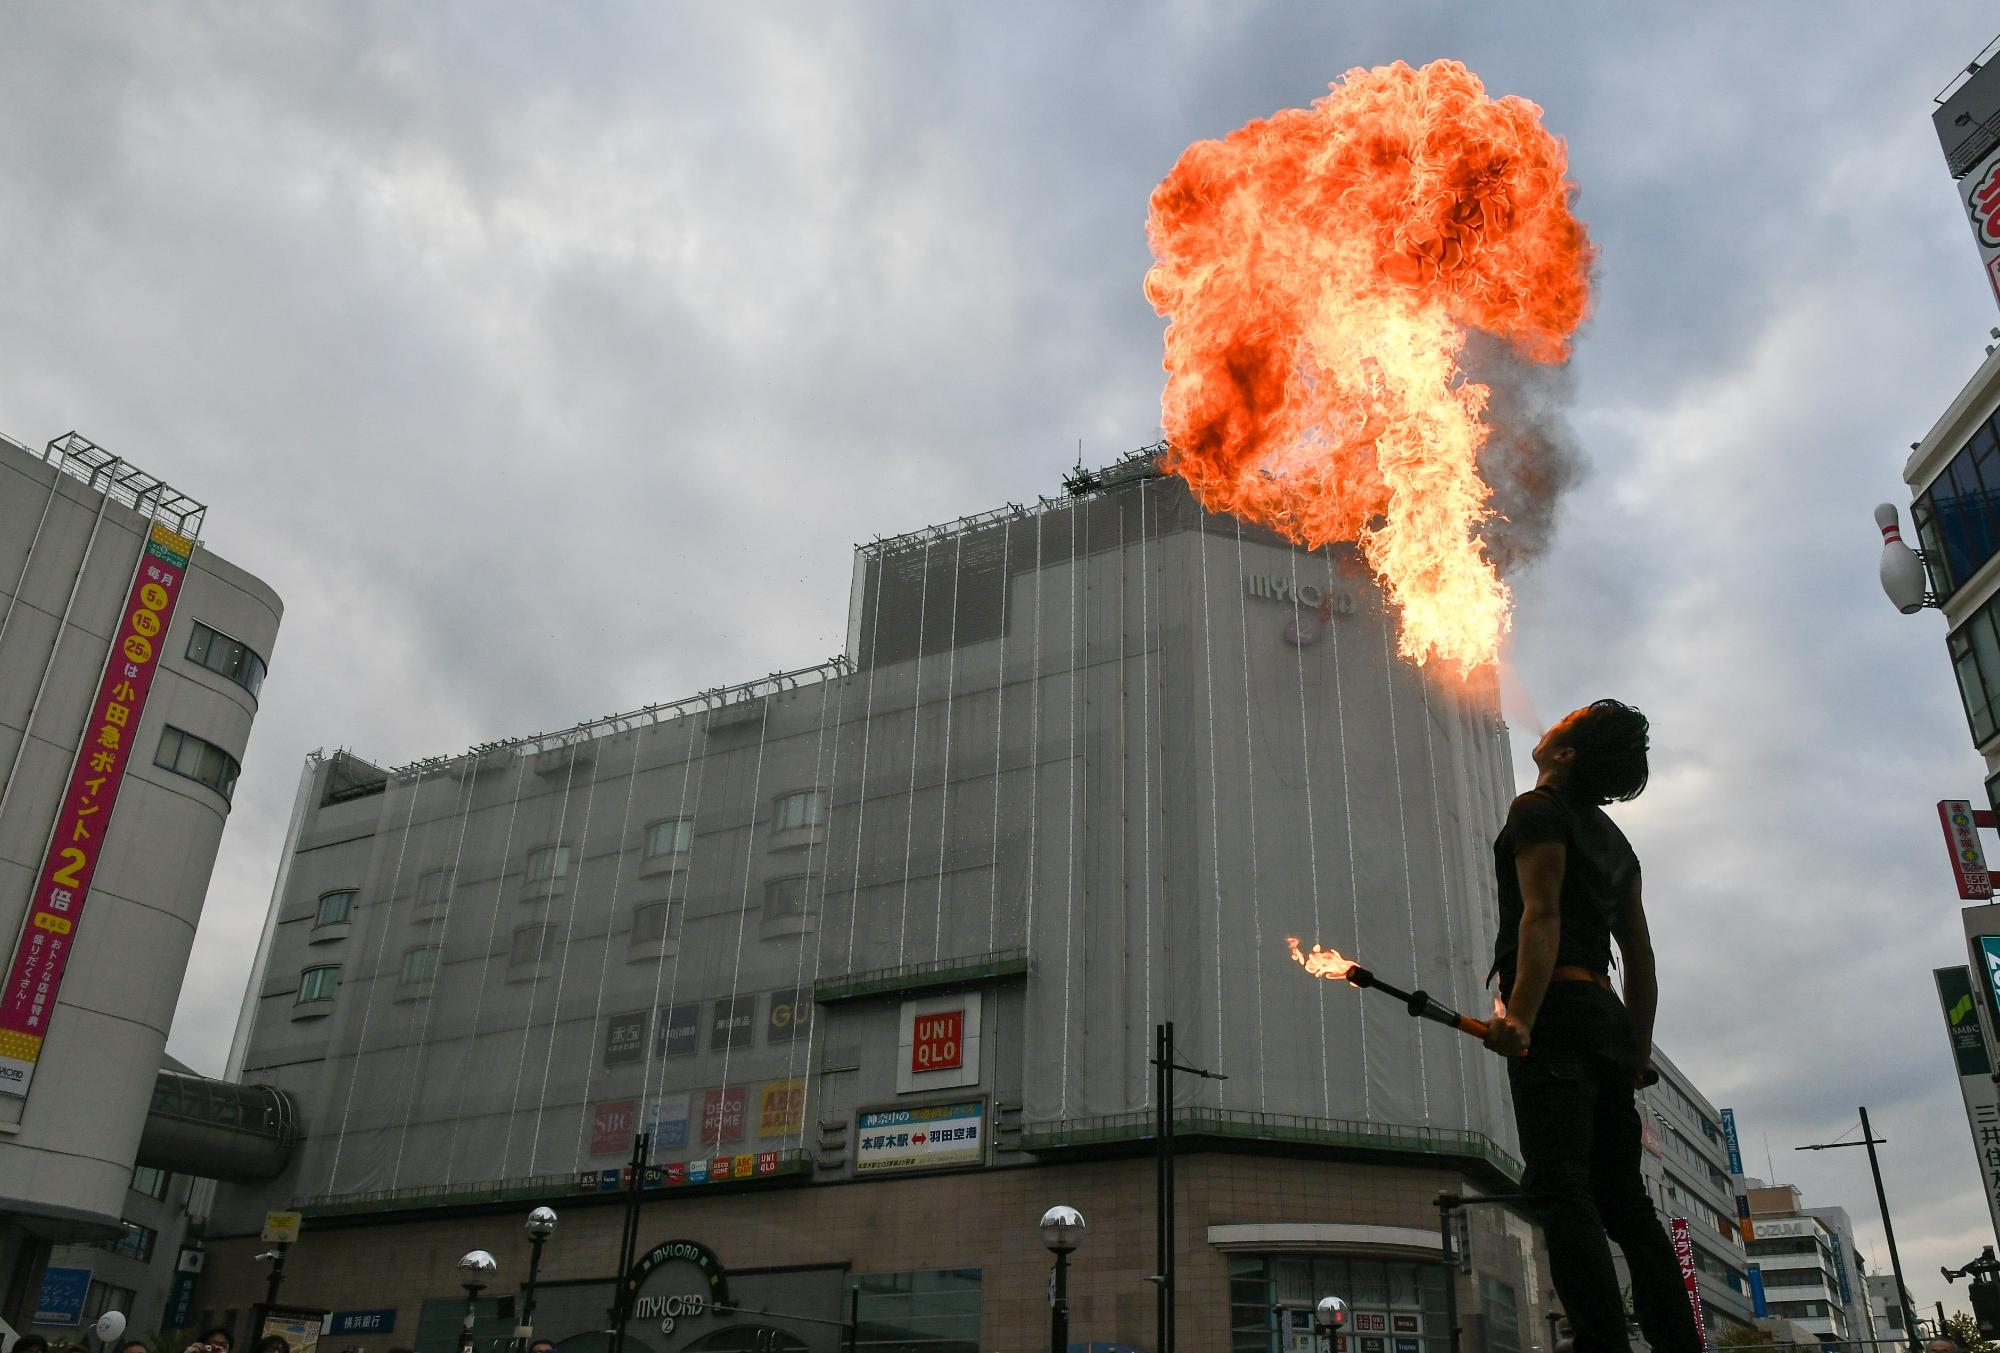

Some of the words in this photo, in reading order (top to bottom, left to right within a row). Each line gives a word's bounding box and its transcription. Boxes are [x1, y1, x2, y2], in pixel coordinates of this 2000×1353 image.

[147, 566, 173, 586] 毎月
[146, 589, 163, 606] 5日
[137, 613, 157, 633] 15日
[125, 639, 149, 659] 25日
[1967, 884, 1990, 895] 24H
[40, 917, 66, 931] さらに
[771, 1002, 812, 1027] GU
[919, 1018, 954, 1041] UNI
[1952, 1024, 1980, 1035] SMBC
[918, 1042, 956, 1067] QLO
[766, 1088, 803, 1111] ABC
[706, 1101, 742, 1117] DECO
[705, 1115, 741, 1129] HOME
[867, 1112, 910, 1126] 神奈中の
[862, 1133, 909, 1150] 本厚木駅
[930, 1126, 977, 1143] 羽田空港
[736, 1157, 752, 1168] ABC
[761, 1152, 775, 1162] UNI
[713, 1162, 729, 1170] DECO
[760, 1161, 775, 1173] QLO
[645, 1169, 661, 1181] GU
[1756, 1223, 1803, 1237] OIZUMI
[653, 1244, 700, 1263] MYLORD
[1675, 1228, 1694, 1279] カラオケ
[636, 1294, 704, 1318] MYLORD
[344, 1315, 381, 1329] 横浜銀行
